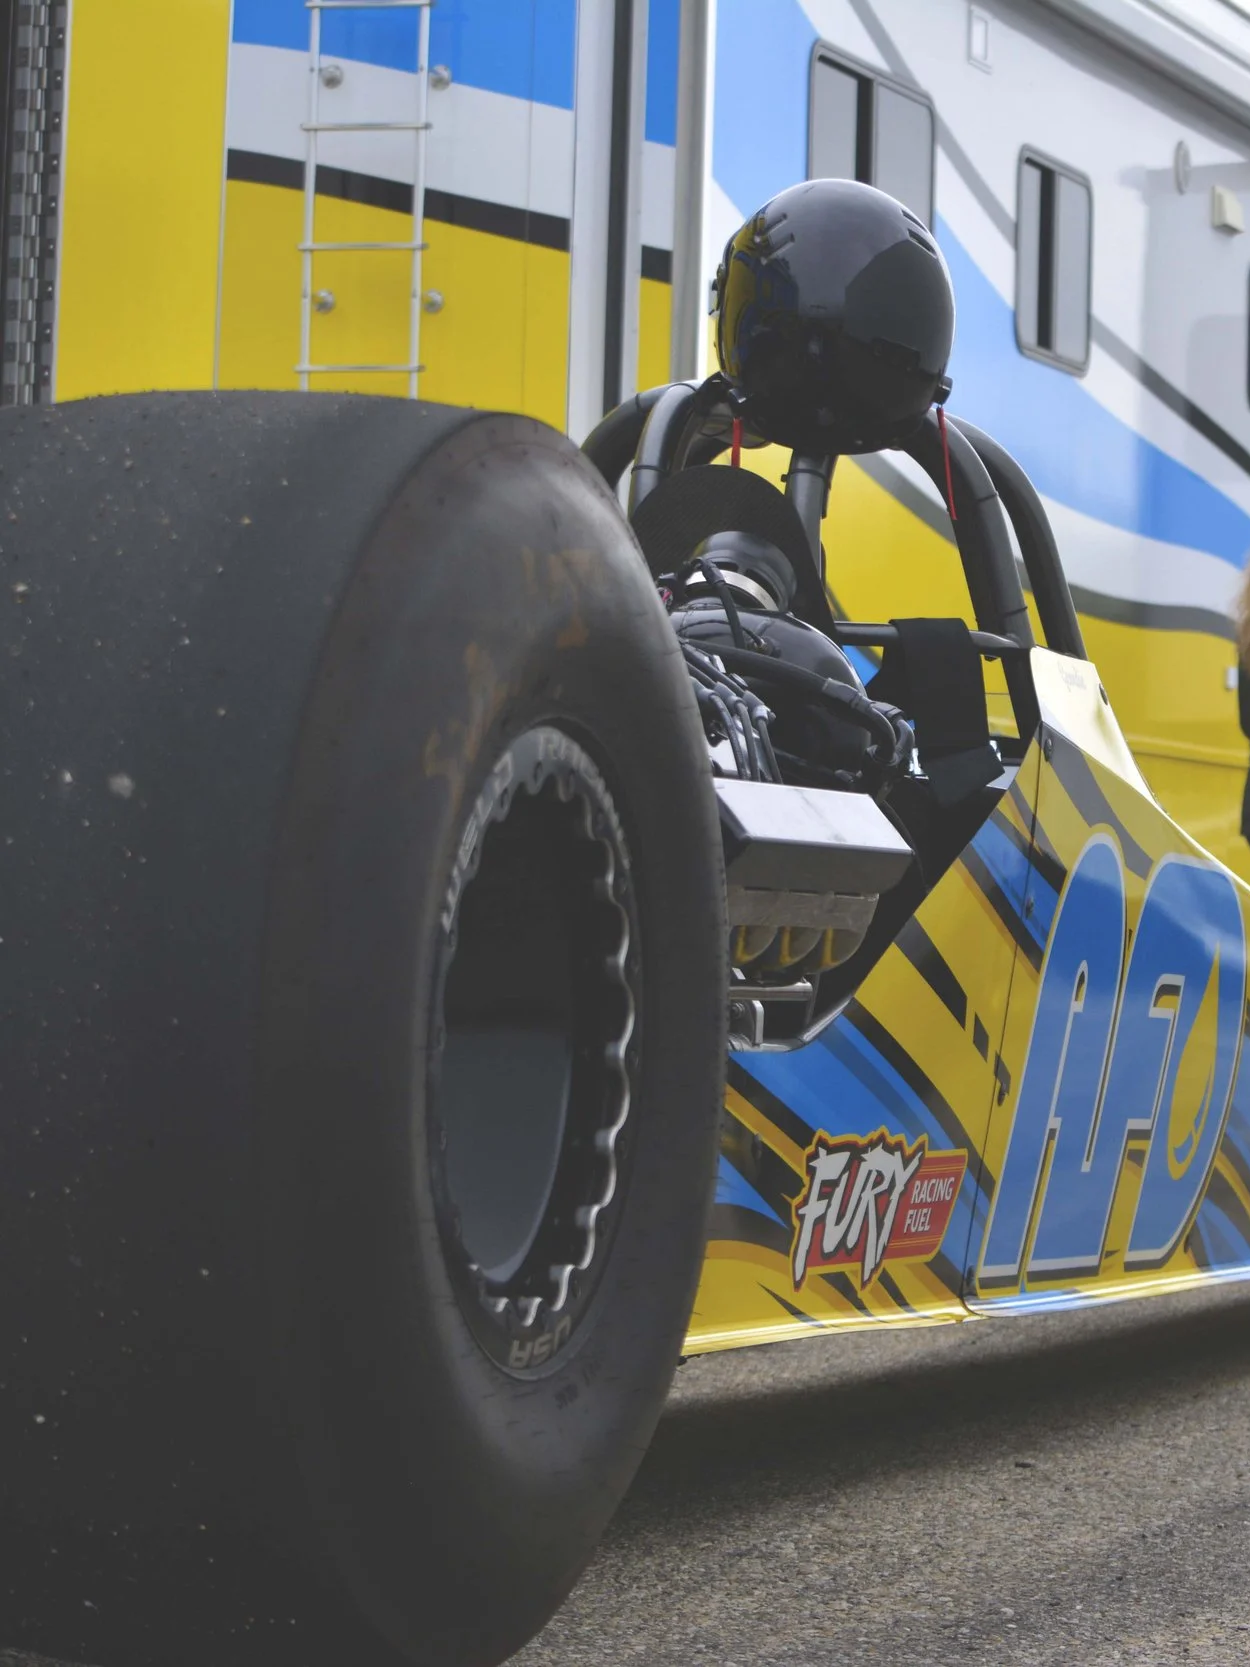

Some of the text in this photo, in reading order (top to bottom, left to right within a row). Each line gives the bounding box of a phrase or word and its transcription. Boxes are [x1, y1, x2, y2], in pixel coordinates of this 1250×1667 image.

[441, 750, 514, 933] WELD
[795, 1142, 924, 1282] FURY
[911, 1176, 955, 1205] RACING
[903, 1207, 932, 1234] FUEL
[508, 1314, 573, 1369] USA
